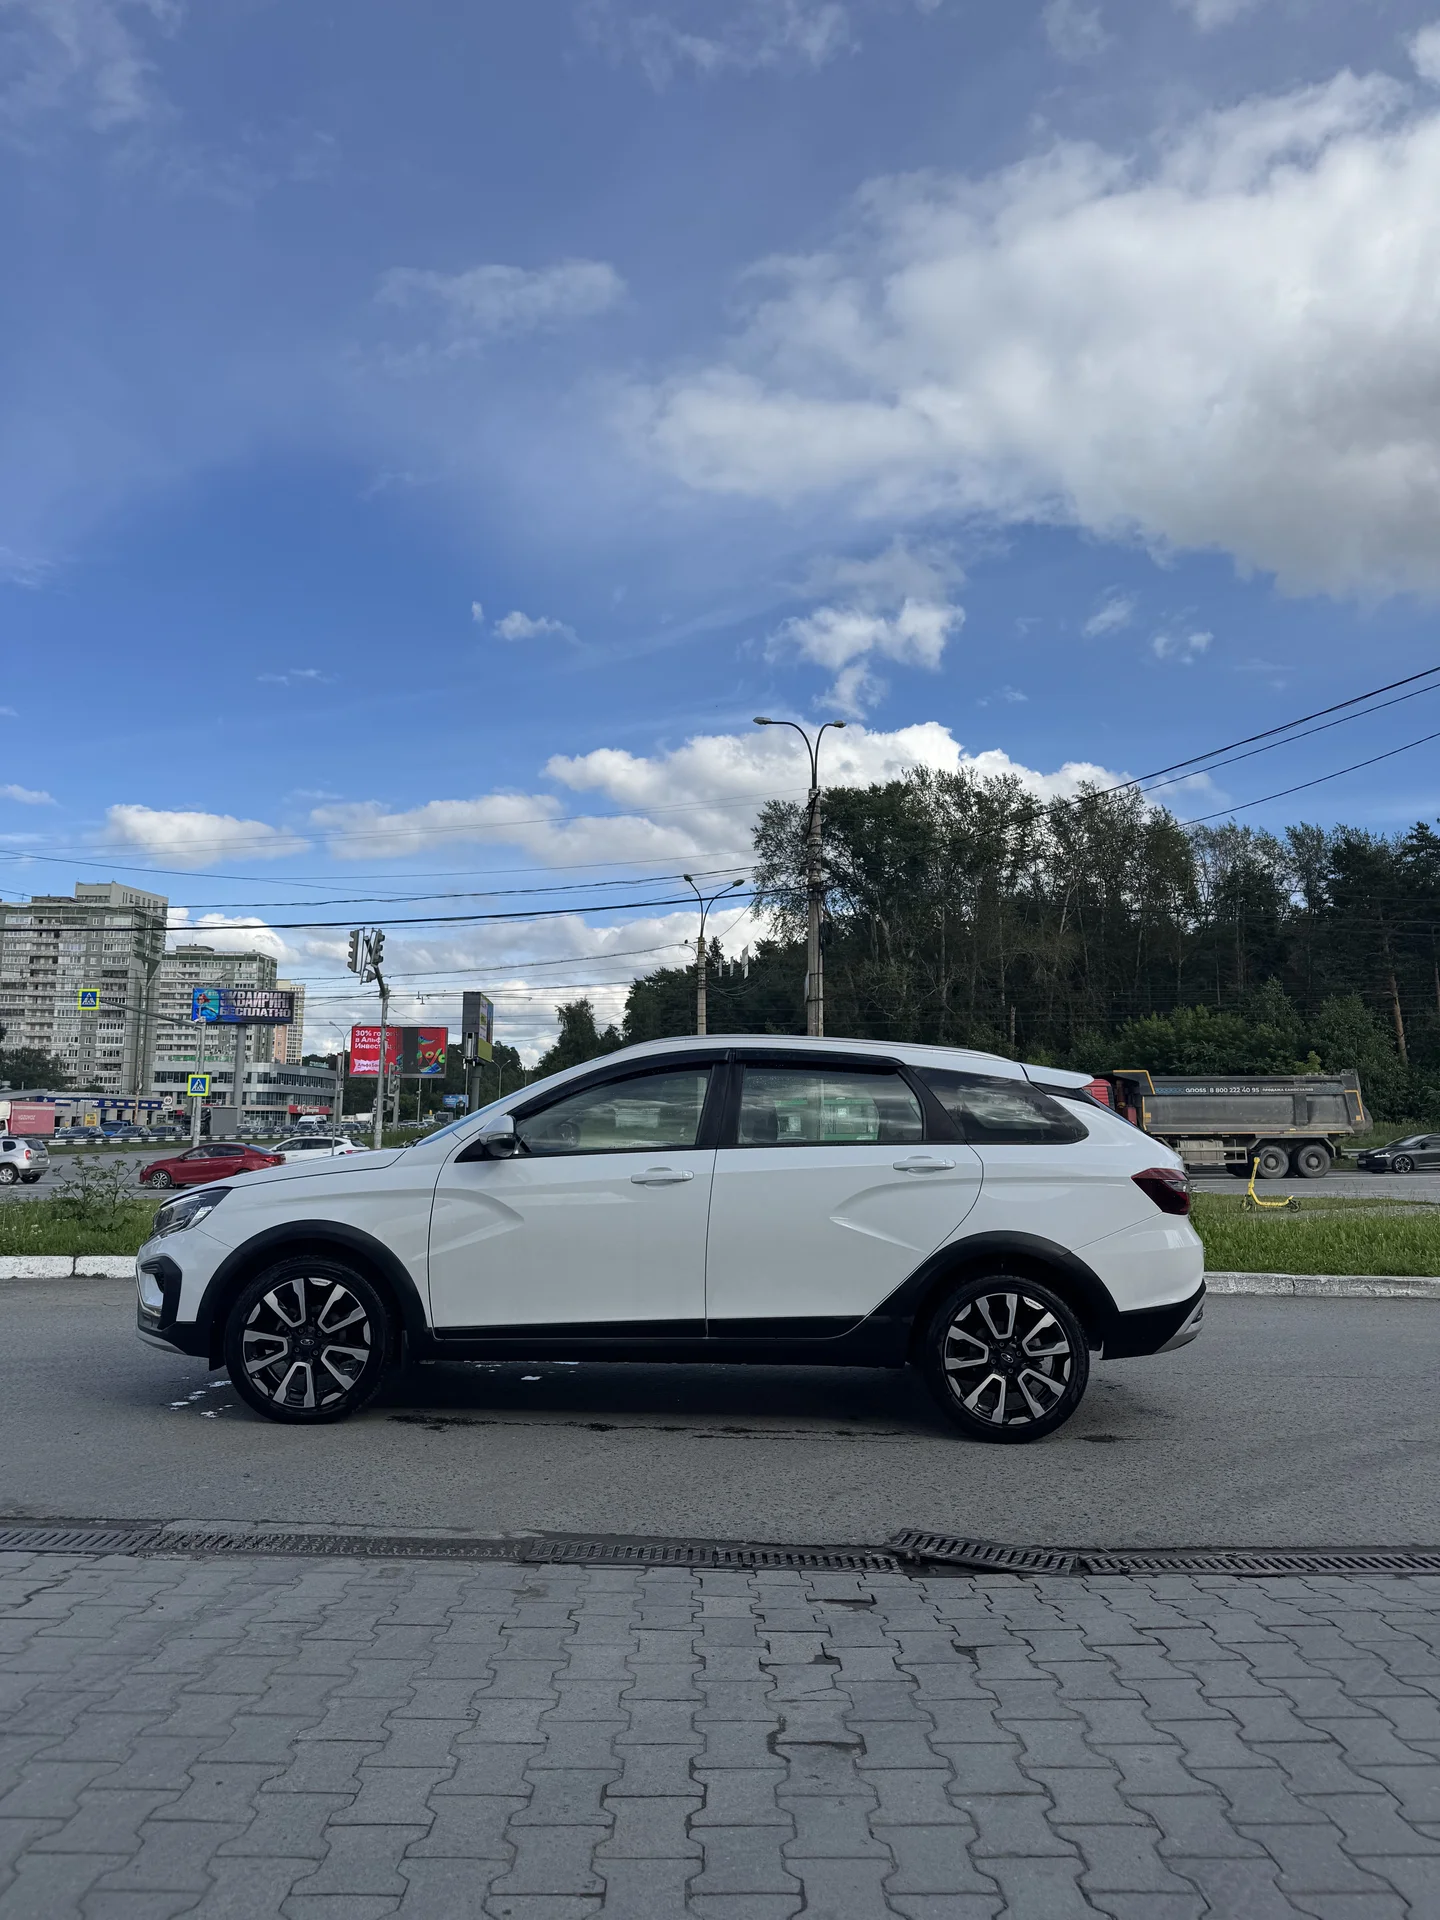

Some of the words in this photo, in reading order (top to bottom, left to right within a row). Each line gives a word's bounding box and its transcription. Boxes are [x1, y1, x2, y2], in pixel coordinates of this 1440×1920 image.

[219, 1007, 292, 1017] БЕСПЛАТНО
[355, 1029, 373, 1037] 30%
[361, 1036, 389, 1044] Альф-
